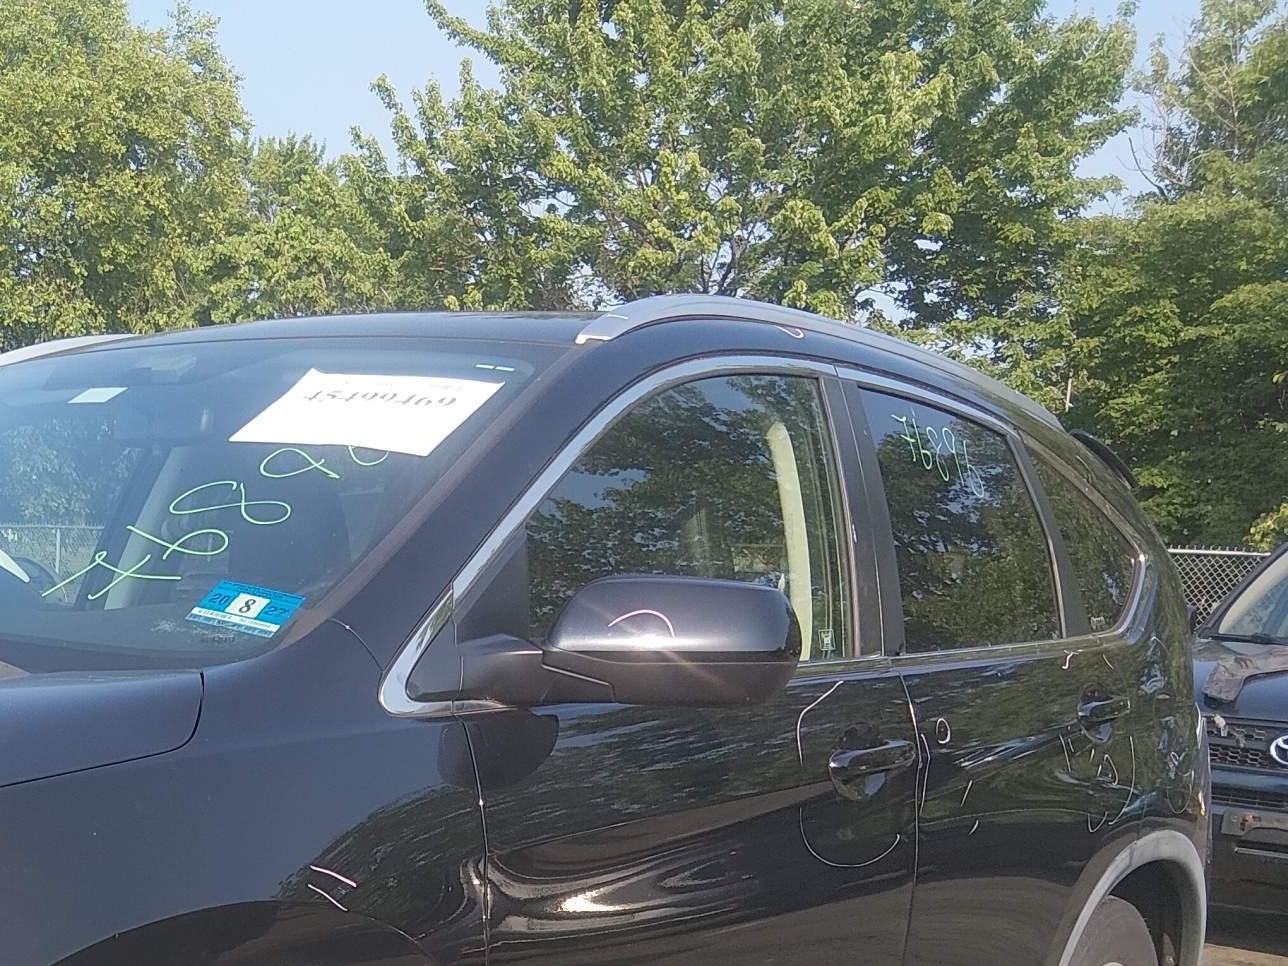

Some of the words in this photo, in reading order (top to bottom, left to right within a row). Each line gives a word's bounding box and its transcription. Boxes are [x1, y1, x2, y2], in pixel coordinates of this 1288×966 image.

[212, 593, 231, 607] 20
[238, 598, 257, 614] 8
[264, 606, 290, 618] 27
